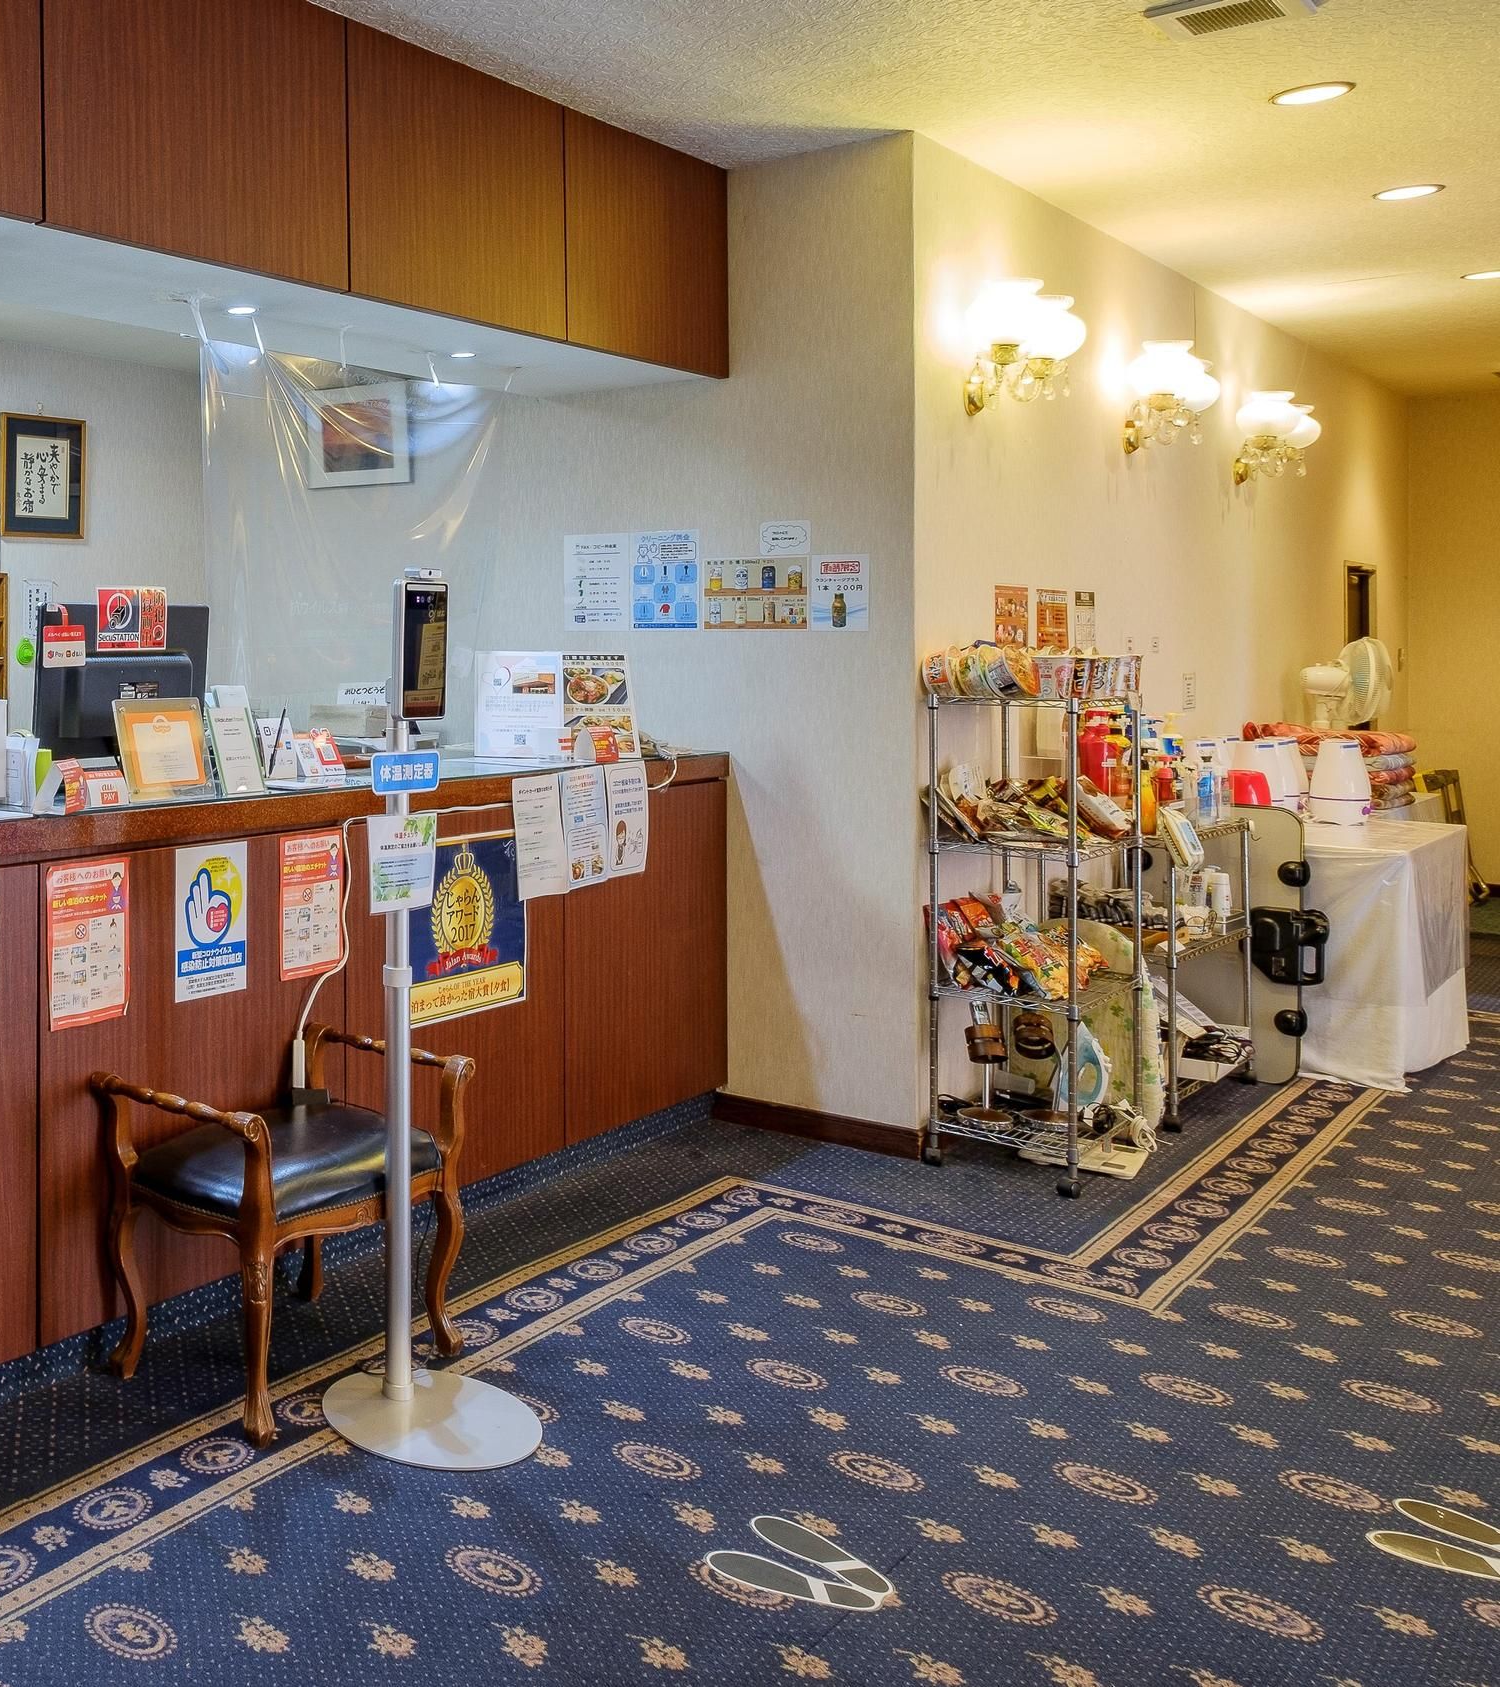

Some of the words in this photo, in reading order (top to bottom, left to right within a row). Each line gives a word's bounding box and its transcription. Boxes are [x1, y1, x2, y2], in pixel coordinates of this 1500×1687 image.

[21, 452, 35, 514] 静かなお宿
[380, 763, 434, 782] 体温測定器
[103, 792, 116, 800] PAY
[445, 887, 481, 909] じゃらん
[446, 905, 480, 926] アワード
[450, 923, 476, 945] 2017
[444, 955, 461, 970] Jalan
[461, 951, 482, 963] Awards
